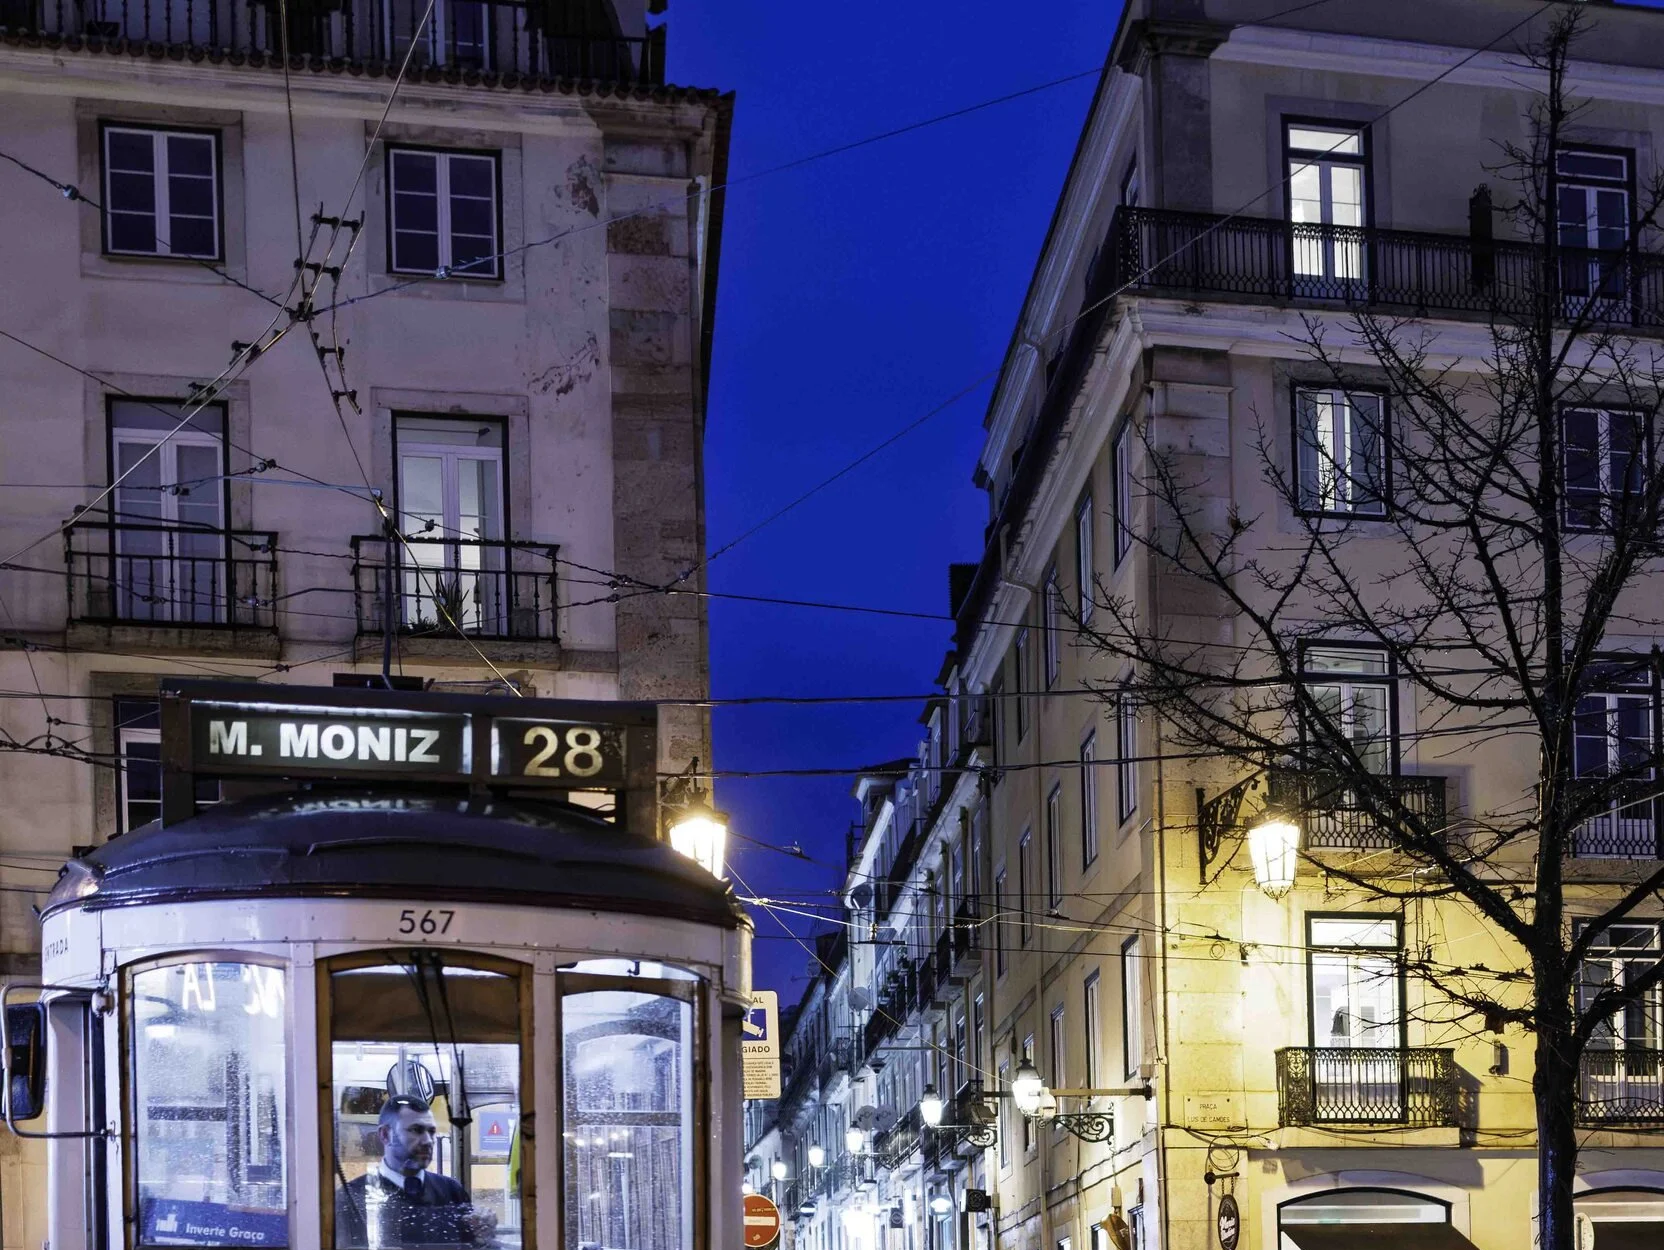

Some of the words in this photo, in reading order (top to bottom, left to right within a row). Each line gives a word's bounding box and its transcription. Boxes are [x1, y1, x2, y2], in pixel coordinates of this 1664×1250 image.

[209, 720, 263, 756] M.
[279, 723, 440, 763] MONIZ
[522, 726, 603, 778] 28
[398, 909, 456, 935] 567
[741, 1045, 771, 1053] GIADO
[185, 1222, 226, 1237] Inverte
[228, 1226, 265, 1243] Graça
